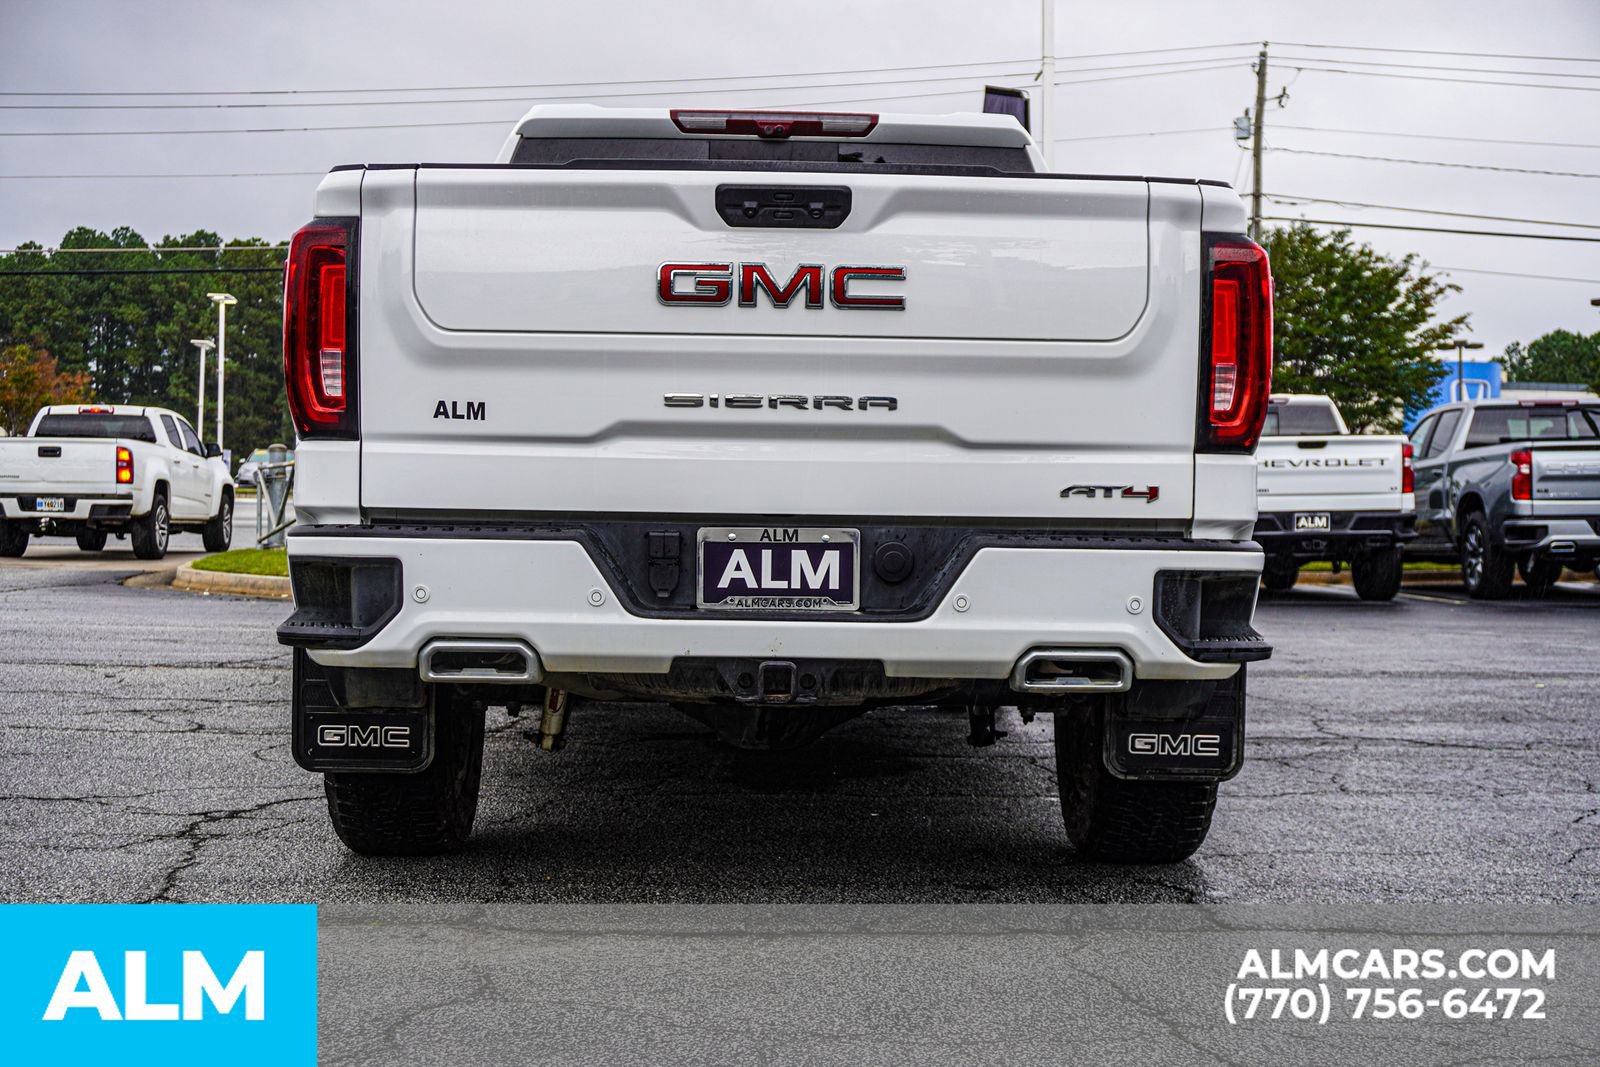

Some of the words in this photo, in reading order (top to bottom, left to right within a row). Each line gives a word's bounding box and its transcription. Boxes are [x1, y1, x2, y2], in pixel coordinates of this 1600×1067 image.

[656, 260, 907, 311] GMC
[433, 400, 486, 421] ALM
[663, 392, 899, 412] SIERRA
[1257, 457, 1389, 469] HEVROLET
[1060, 484, 1160, 504] AT4
[1297, 515, 1328, 529] ALM
[759, 528, 799, 542] ALM
[717, 548, 840, 590] ALM
[736, 598, 822, 608] ALMCARS.COM
[317, 725, 410, 748] GMC
[1128, 733, 1220, 756] GMC
